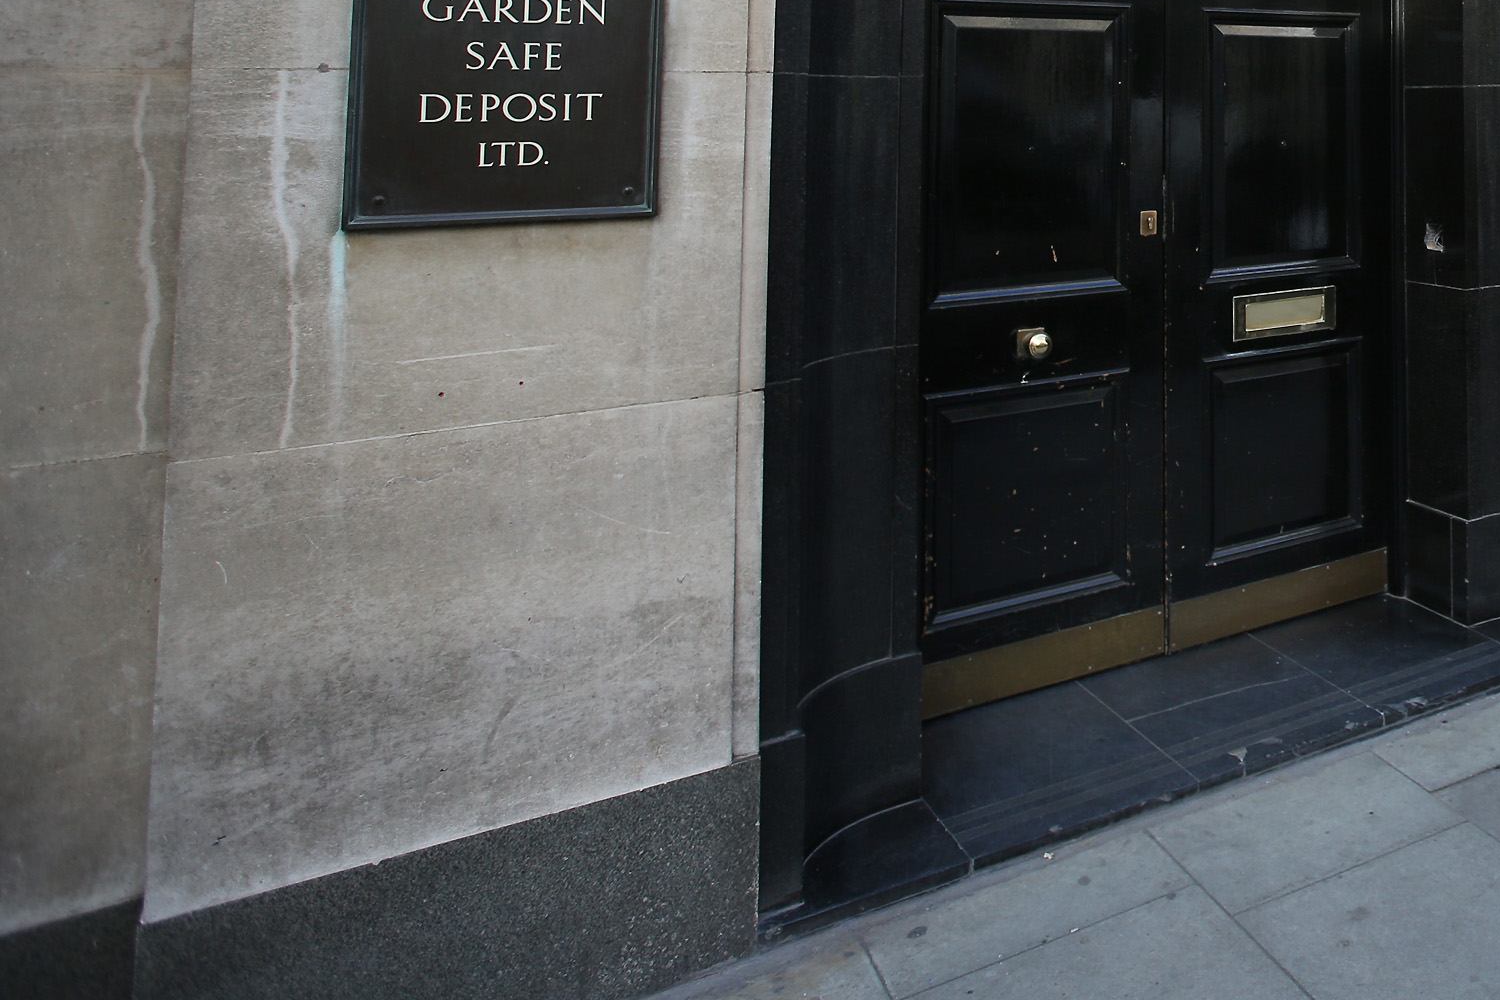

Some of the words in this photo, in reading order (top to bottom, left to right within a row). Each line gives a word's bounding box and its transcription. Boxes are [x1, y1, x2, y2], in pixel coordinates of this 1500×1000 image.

[465, 41, 563, 71] SAFE
[418, 92, 604, 124] DEPOSIT
[477, 141, 550, 168] LTD.
